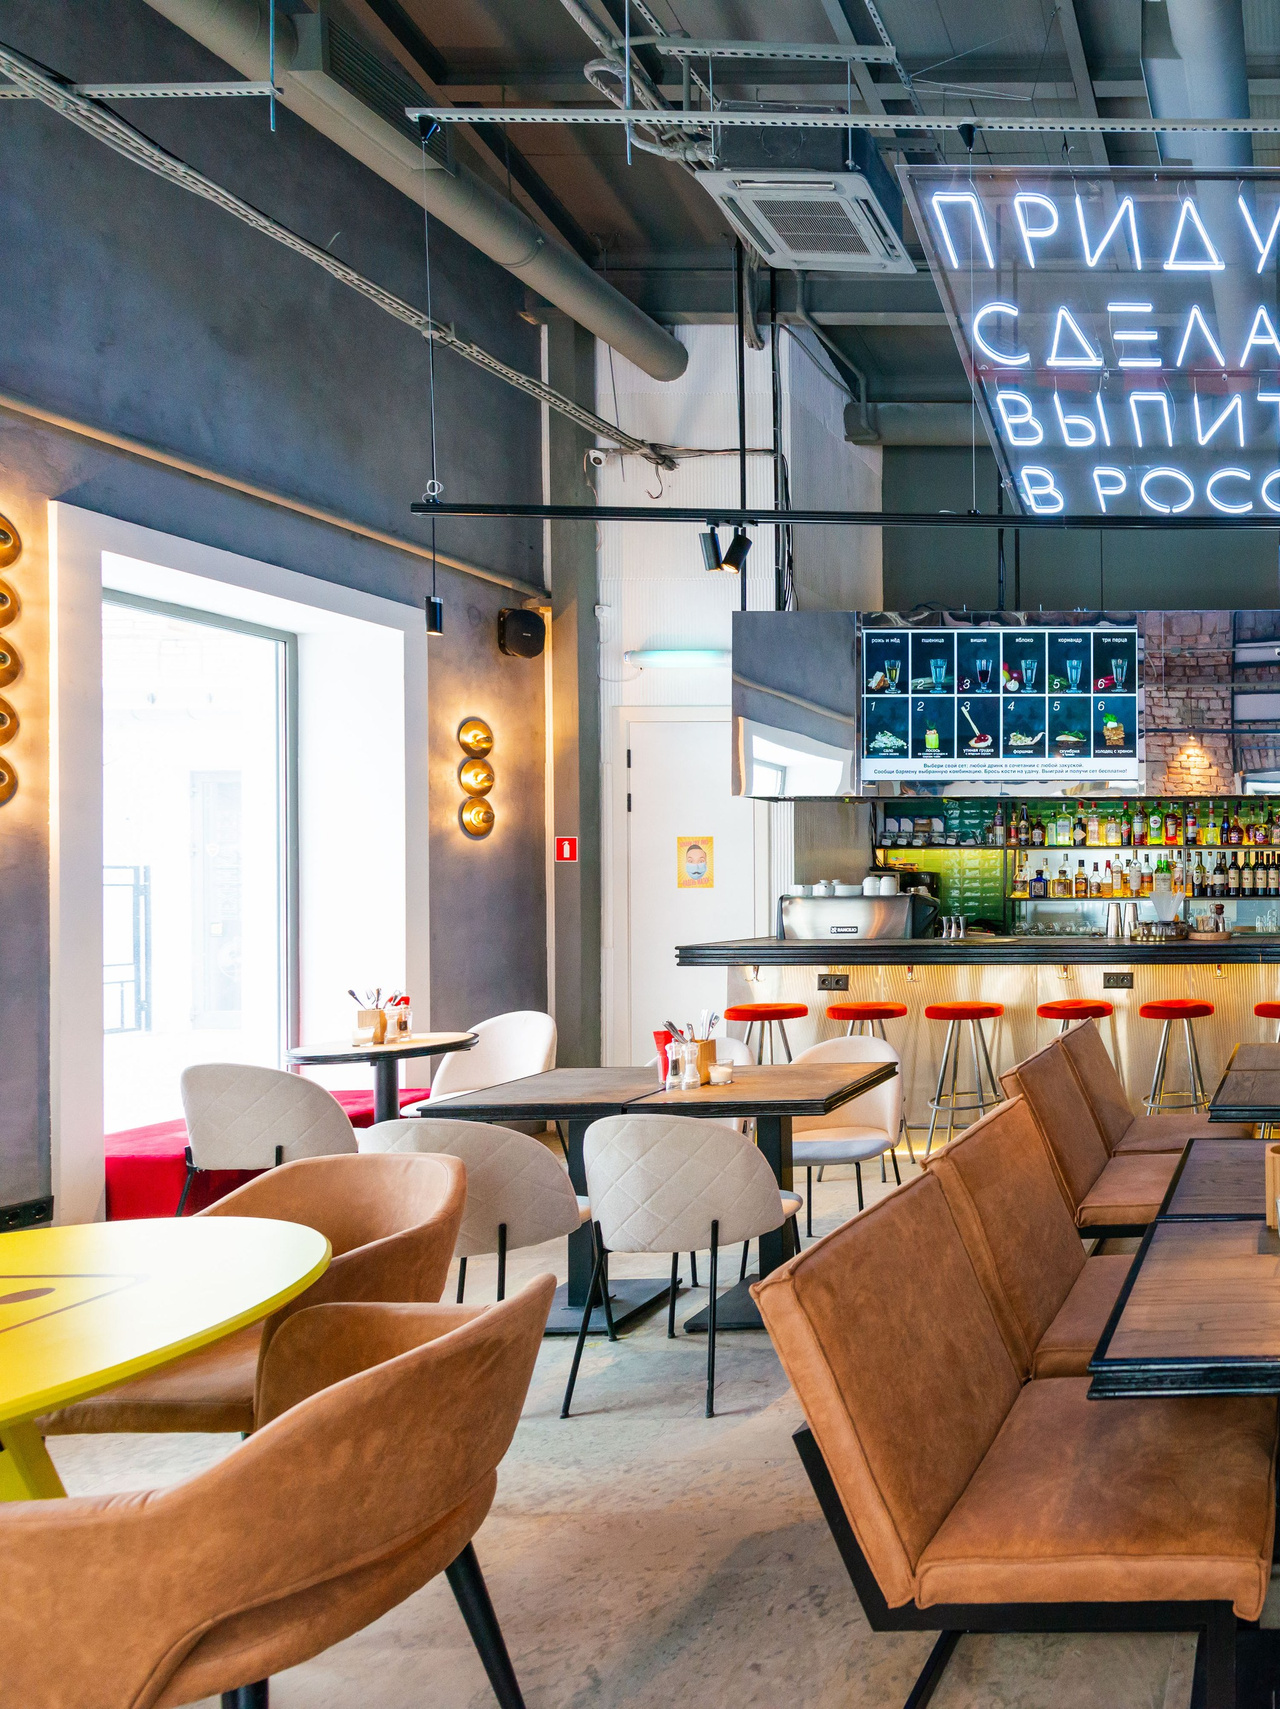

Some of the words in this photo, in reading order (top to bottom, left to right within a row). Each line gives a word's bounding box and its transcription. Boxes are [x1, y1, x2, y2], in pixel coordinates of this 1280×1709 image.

[1020, 466, 1065, 514] В
[917, 680, 925, 689] 2
[963, 679, 971, 689] 3
[1053, 679, 1060, 689] 5
[1098, 679, 1106, 689] 6
[871, 701, 876, 711] 1
[917, 701, 925, 711] 2
[963, 701, 971, 711] 3
[1007, 701, 1015, 711] 4
[1053, 701, 1060, 711] 5
[1098, 701, 1106, 711] 6
